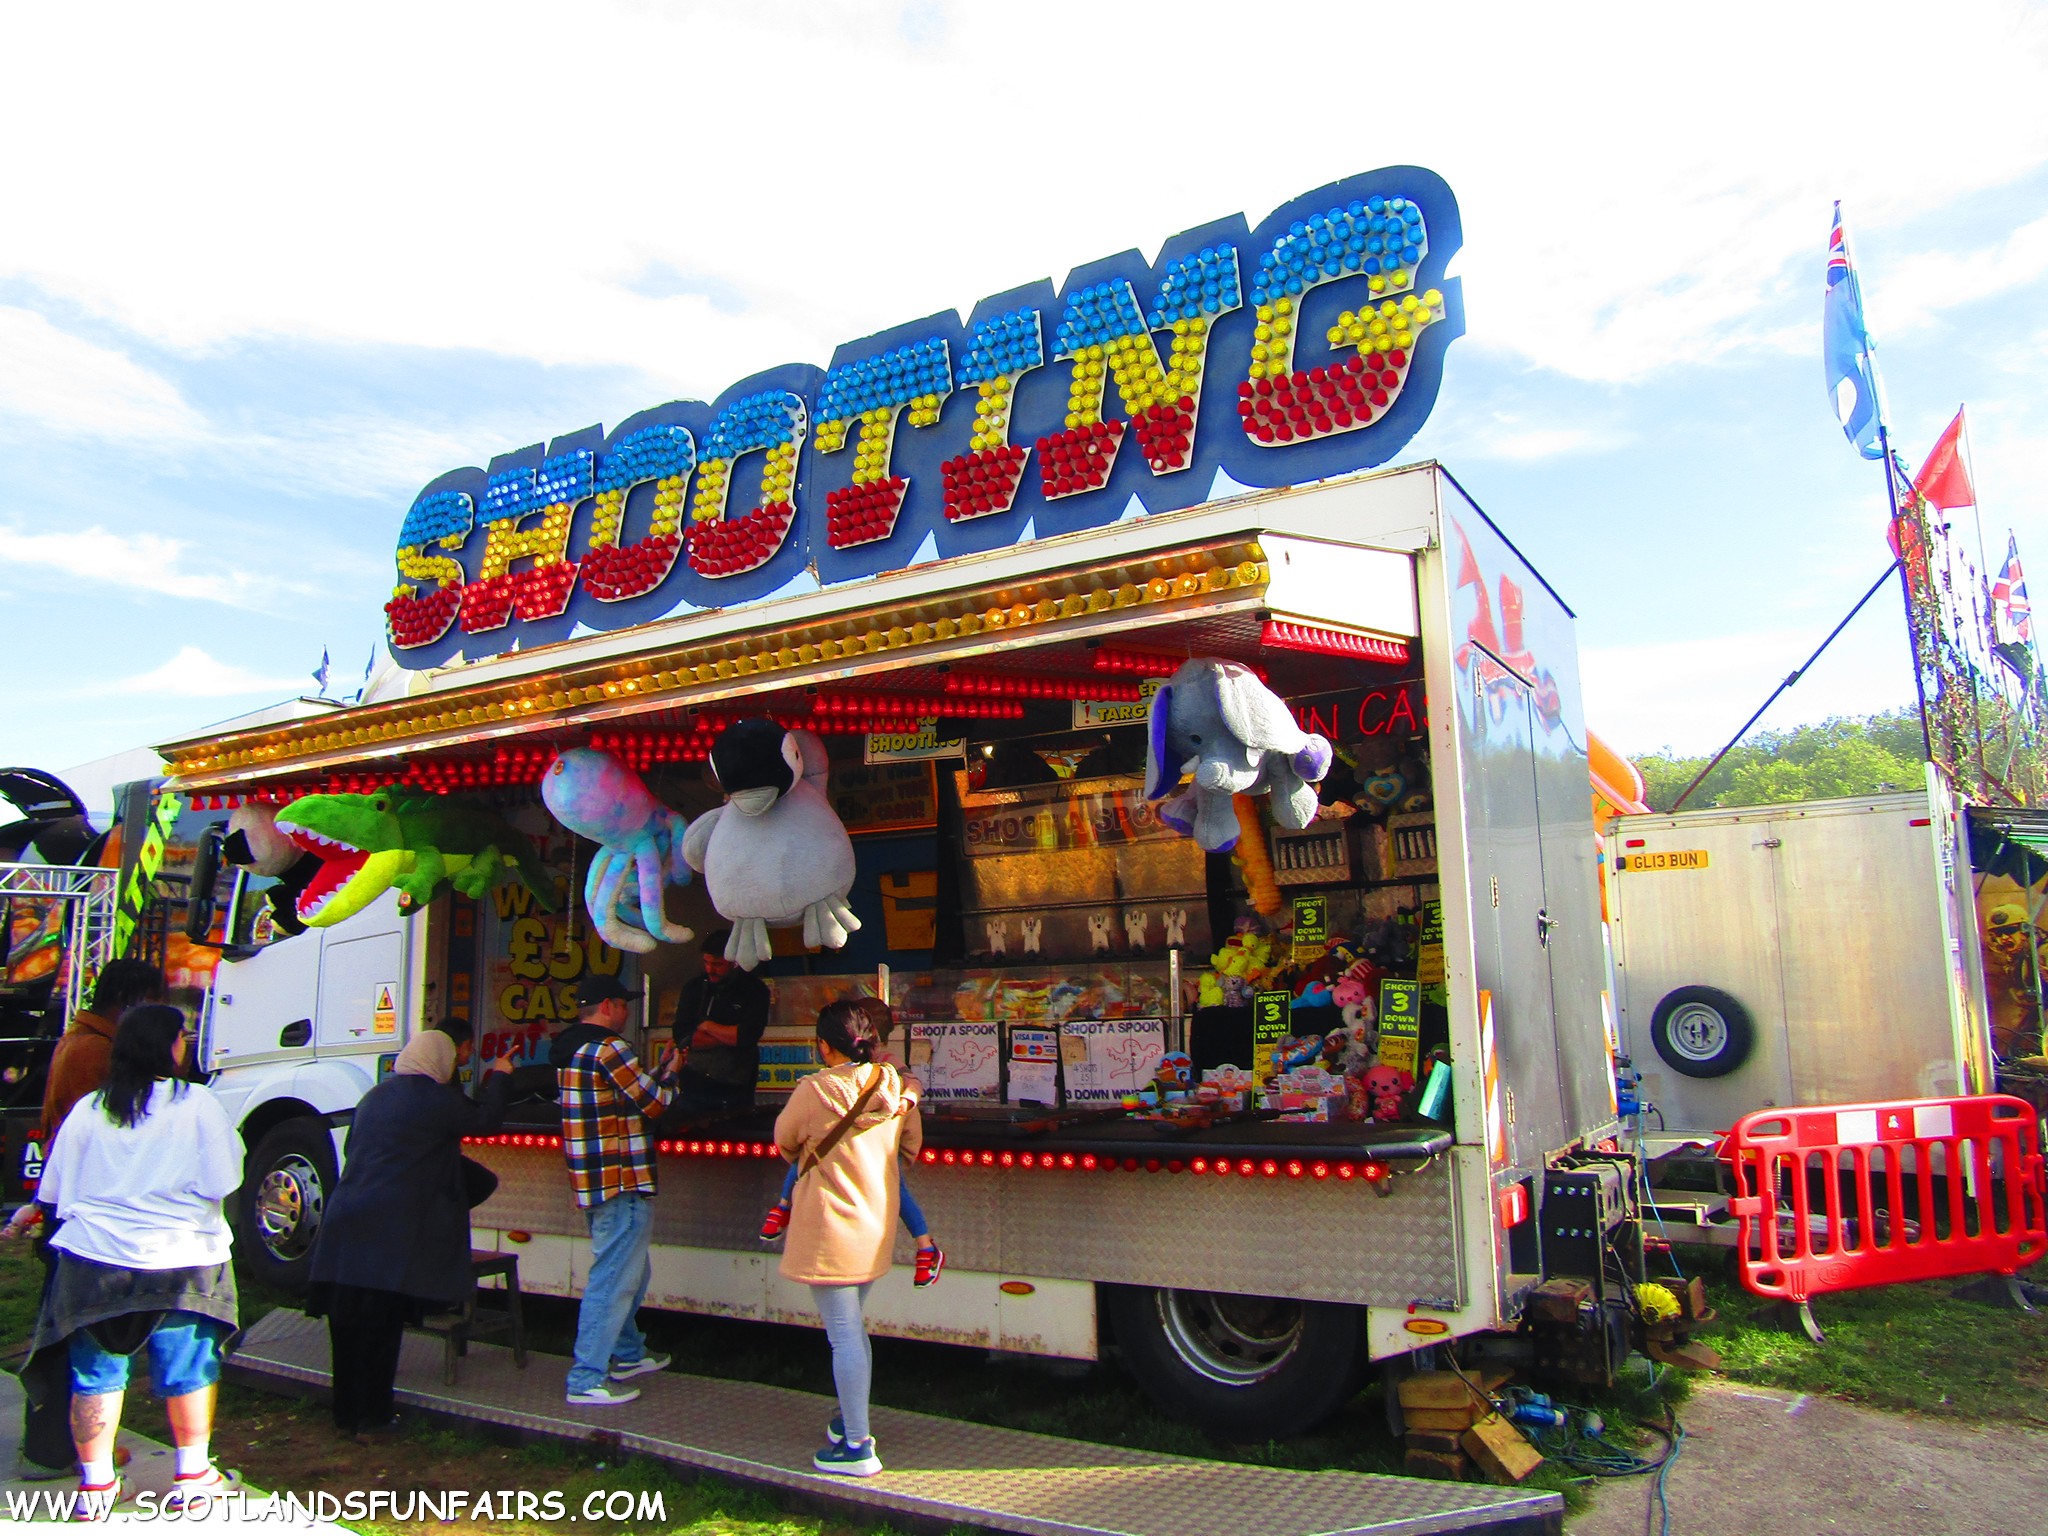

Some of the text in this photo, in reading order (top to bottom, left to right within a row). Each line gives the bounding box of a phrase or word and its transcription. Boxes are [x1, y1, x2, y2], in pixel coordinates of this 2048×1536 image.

[386, 196, 1445, 645] SHOOTING
[1634, 853, 1698, 868] GL13 BUN
[1296, 900, 1323, 908] SHOOT
[1302, 908, 1317, 926] 3
[1297, 927, 1323, 935] DOWN
[1295, 933, 1326, 942] TO WIN
[1384, 983, 1417, 991] SHOOT
[500, 983, 580, 1023] CAS
[1257, 995, 1286, 1003] SHOOT
[1391, 992, 1409, 1012] 3
[1264, 1003, 1281, 1021] 3
[1384, 1014, 1415, 1023] DOWN
[912, 1024, 997, 1037] SHOOT A SPOOK
[1063, 1021, 1160, 1035] SHOOT A SPOOK
[1258, 1023, 1287, 1031] DOWN
[1382, 1022, 1418, 1032] TO WIN
[1014, 1033, 1030, 1041] VISA
[481, 1029, 543, 1063] BEAT
[952, 1087, 980, 1098] WINS
[1075, 1089, 1109, 1100] DOWN
